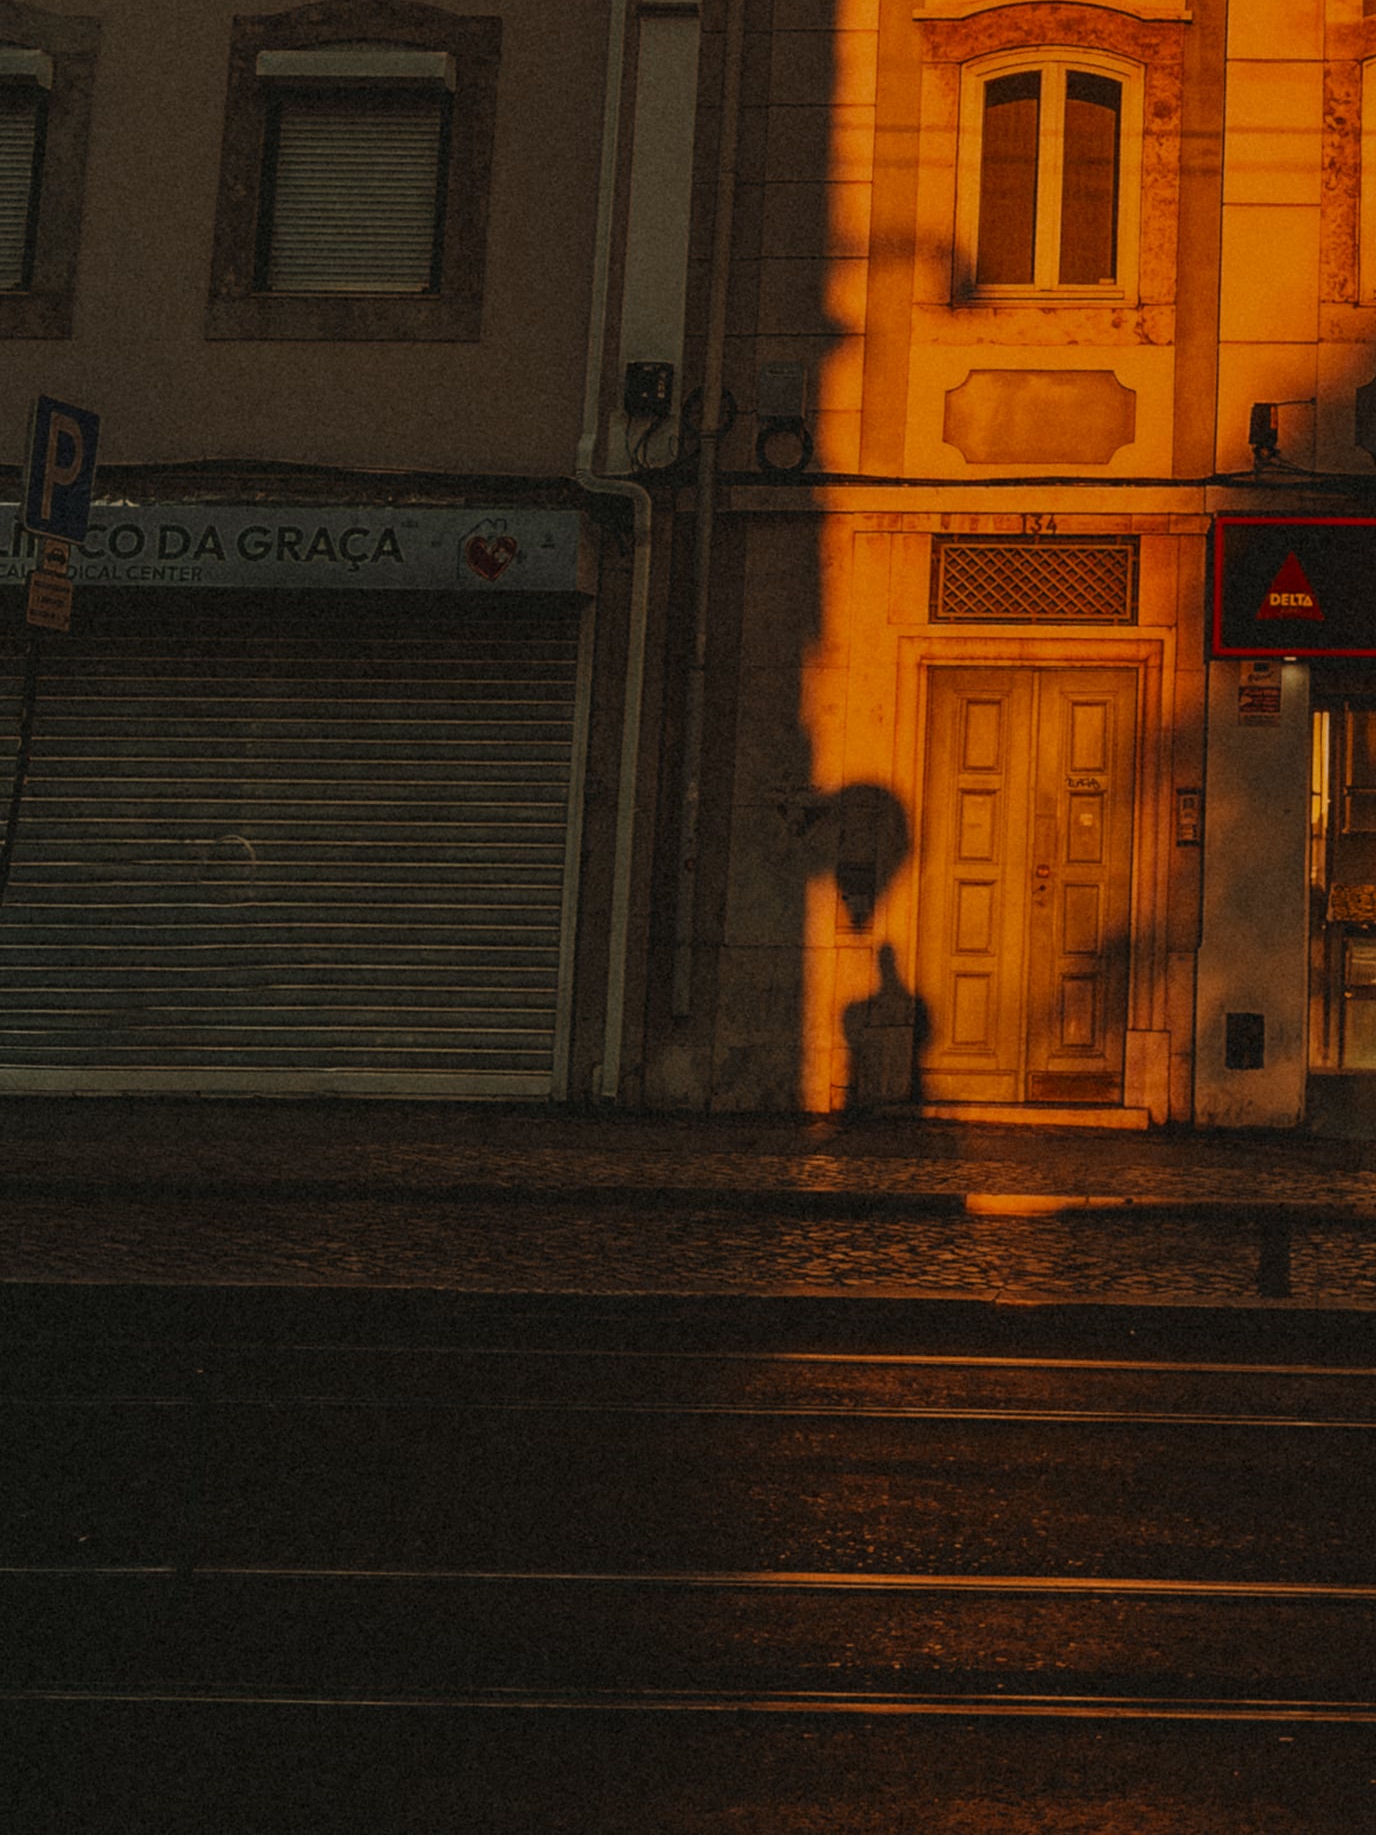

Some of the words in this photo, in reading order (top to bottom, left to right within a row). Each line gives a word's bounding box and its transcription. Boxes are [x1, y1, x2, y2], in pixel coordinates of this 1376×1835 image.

[40, 410, 84, 521] P
[1020, 513, 1058, 535] 134
[158, 523, 226, 561] DA
[236, 524, 404, 573] GRAÇA
[126, 565, 203, 582] CENTER
[1269, 592, 1314, 607] DELTA
